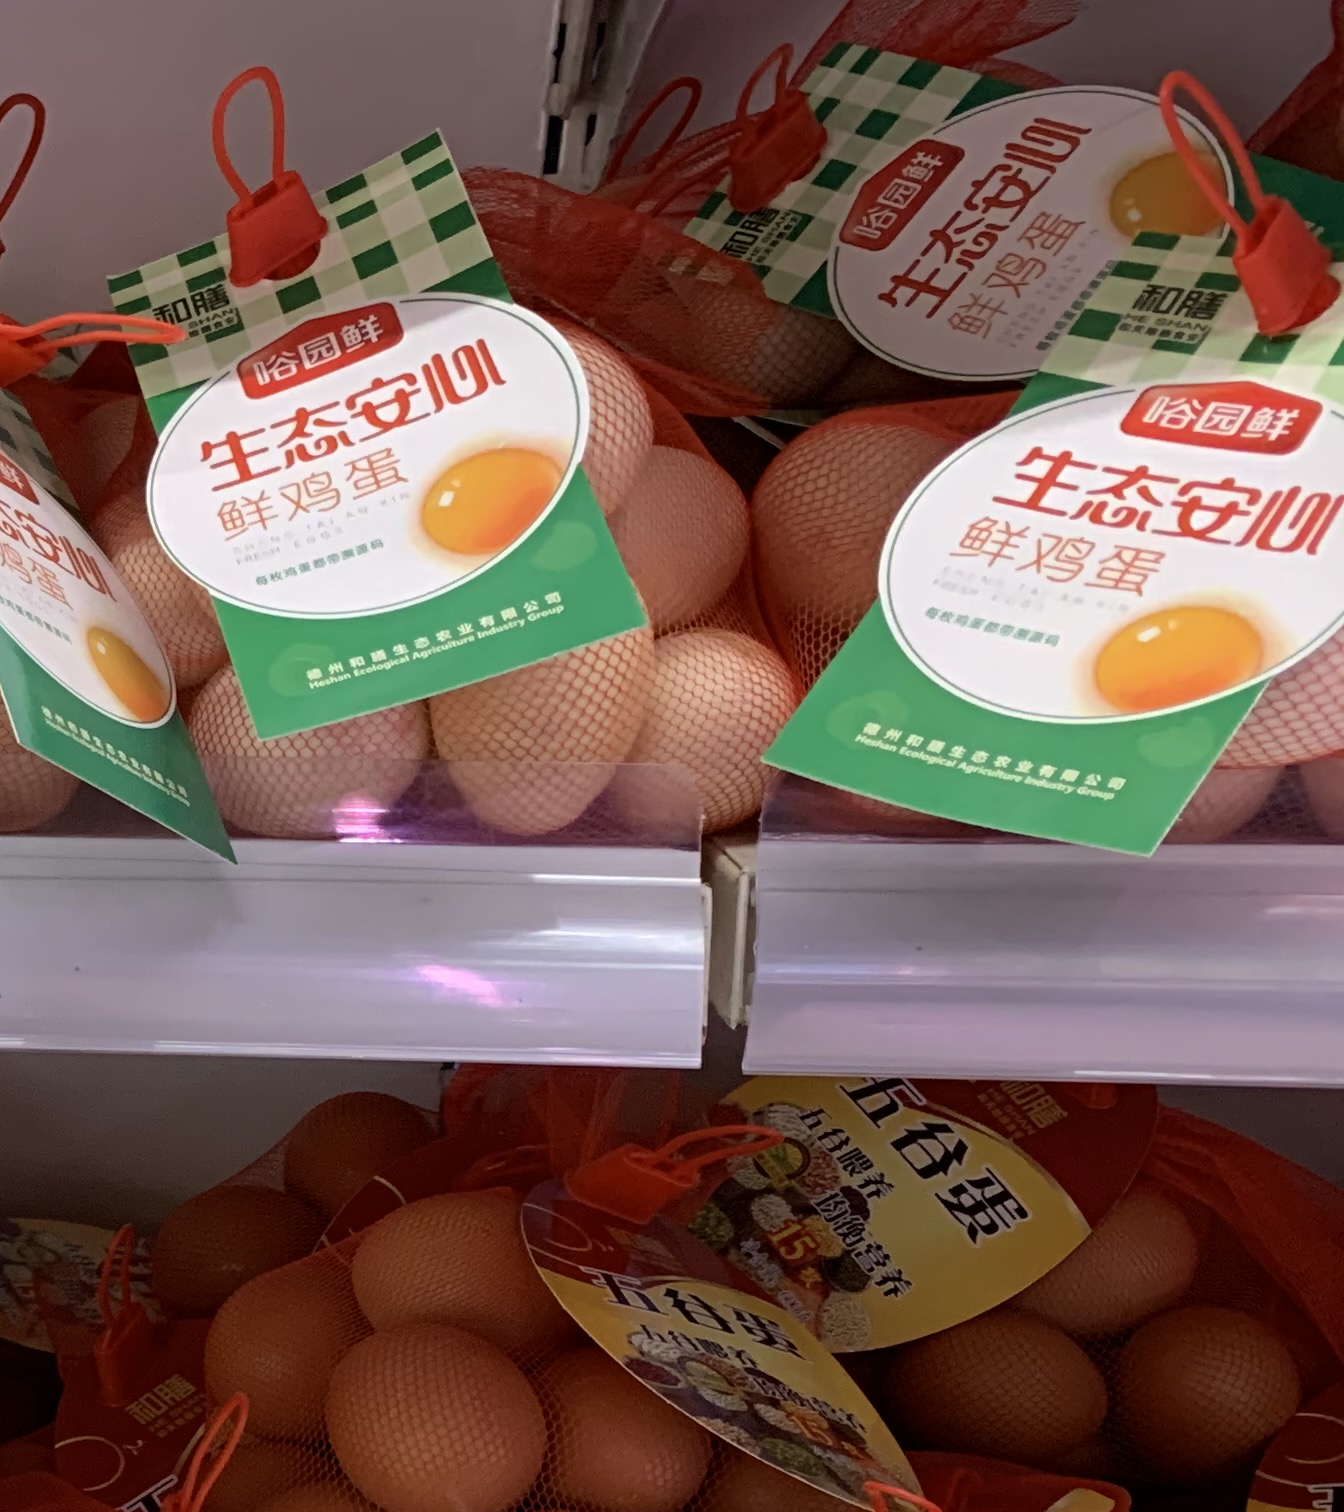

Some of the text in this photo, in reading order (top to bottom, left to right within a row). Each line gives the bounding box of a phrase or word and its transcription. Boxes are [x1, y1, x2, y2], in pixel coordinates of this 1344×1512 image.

[878, 117, 1093, 319] 生态安心
[152, 286, 231, 326] 和膳
[947, 211, 1088, 339] 鲜鸡蛋
[1131, 284, 1239, 321] 和膳
[1157, 317, 1210, 334] SHAN
[200, 338, 506, 493] 生态安心
[216, 448, 409, 541] 鲜鸡蛋
[992, 446, 1344, 556] 生态安心
[950, 516, 1166, 597] 鲜鸡蛋
[309, 605, 564, 689] Heshan Ecological Agriculture Industry Group
[854, 734, 1115, 800] Heshan Ecological Agriculture Industry Group
[797, 1106, 895, 1200] 五谷喂养
[838, 1078, 1032, 1246] 五谷蛋
[767, 1218, 817, 1262] 15
[814, 1192, 916, 1300] 均衡营养
[581, 1265, 812, 1364] 五谷蛋
